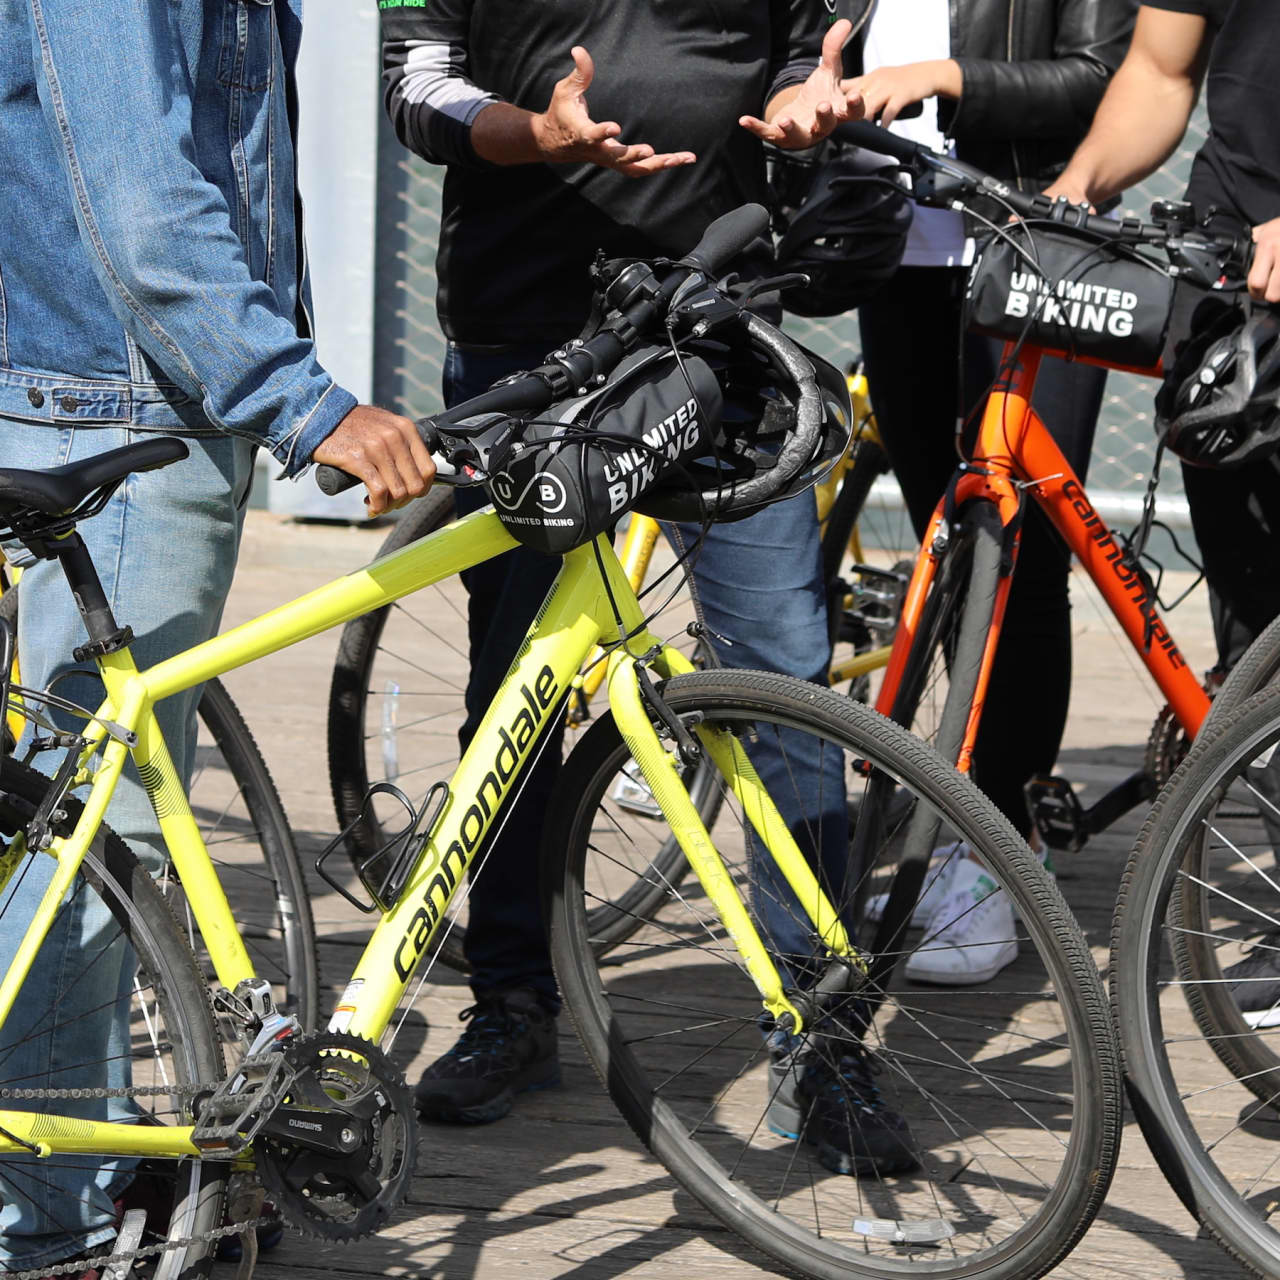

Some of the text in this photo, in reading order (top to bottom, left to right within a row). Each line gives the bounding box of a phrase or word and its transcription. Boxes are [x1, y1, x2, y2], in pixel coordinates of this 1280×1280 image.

[603, 397, 699, 483] UNLMITED
[500, 513, 575, 527] UNLIMITED BIKING
[1061, 478, 1187, 670] cannonale
[393, 664, 559, 985] cannondale
[288, 1118, 323, 1132] SHIMANO
